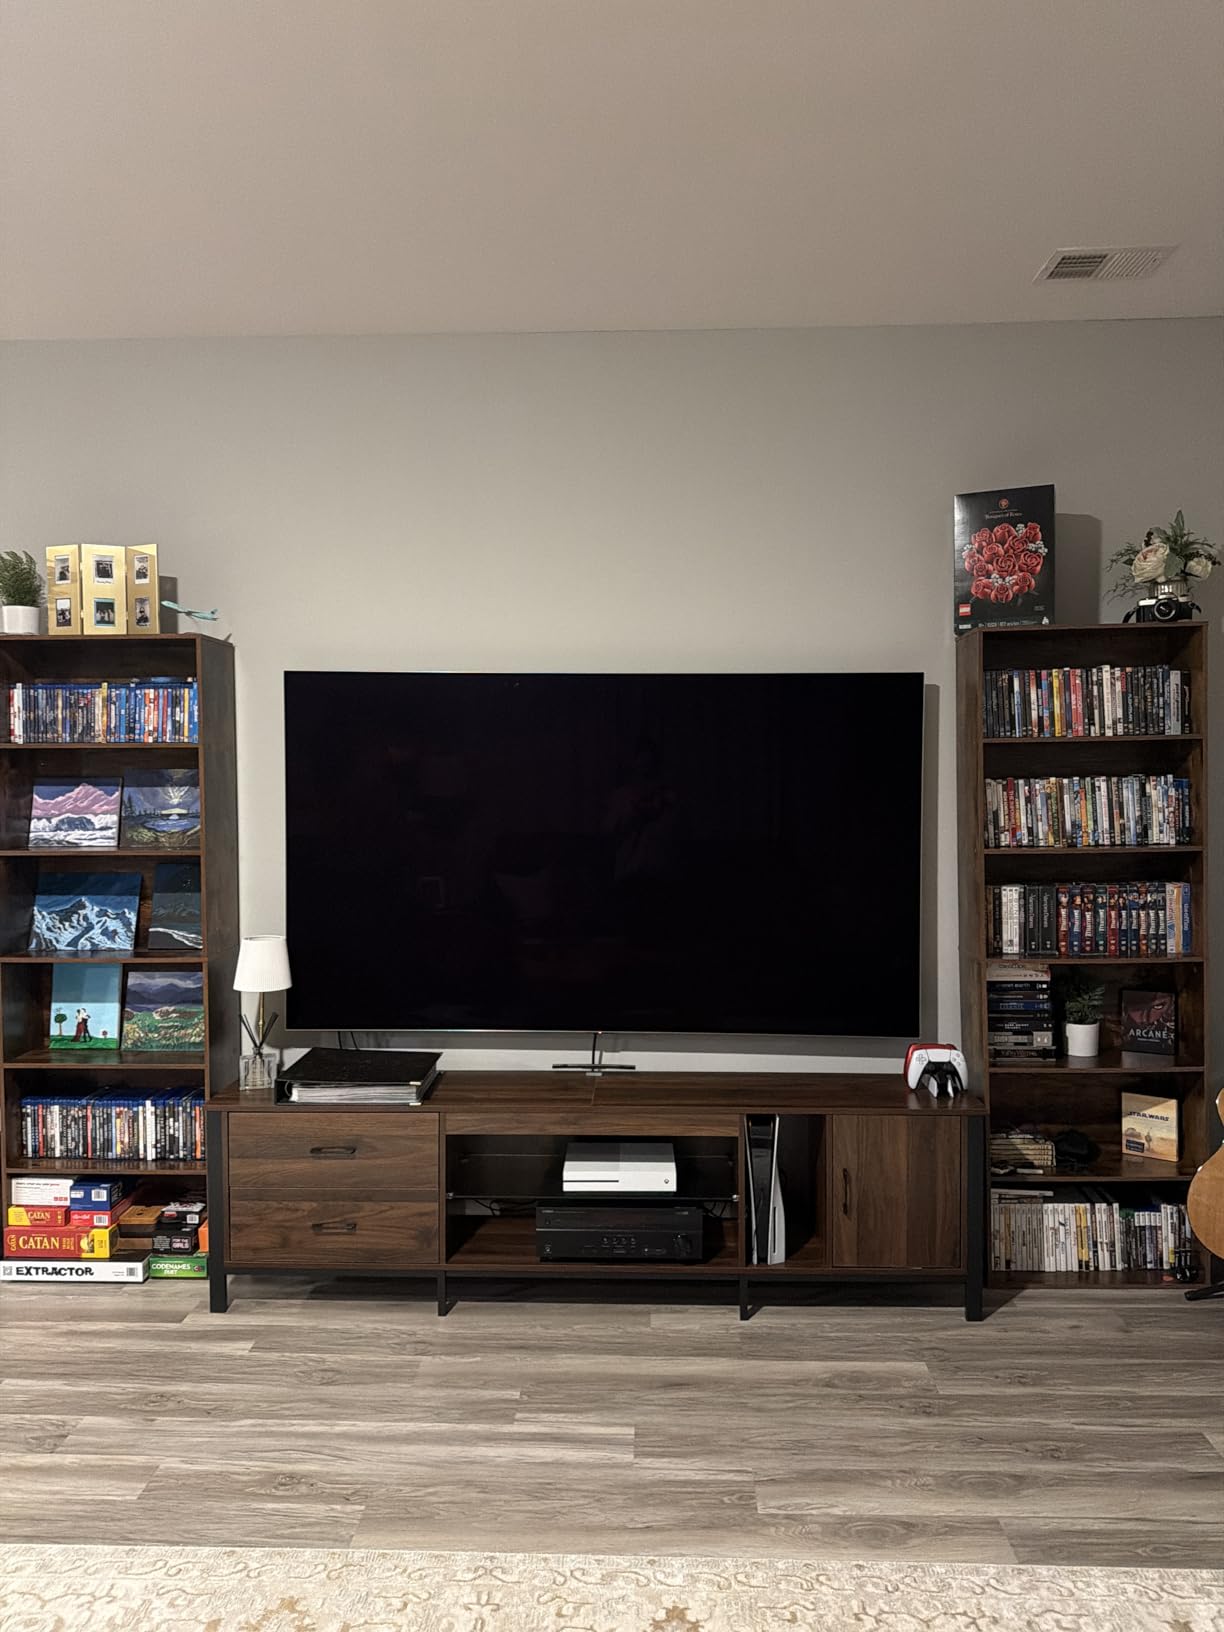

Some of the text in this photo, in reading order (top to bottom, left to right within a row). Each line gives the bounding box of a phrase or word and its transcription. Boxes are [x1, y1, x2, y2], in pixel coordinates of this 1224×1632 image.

[1129, 1029, 1168, 1039] ARCANE
[1148, 1114, 1169, 1122] WARS
[28, 1211, 51, 1219] CATAN
[19, 1236, 60, 1250] CATAN
[16, 1266, 94, 1277] EXTRACTOR
